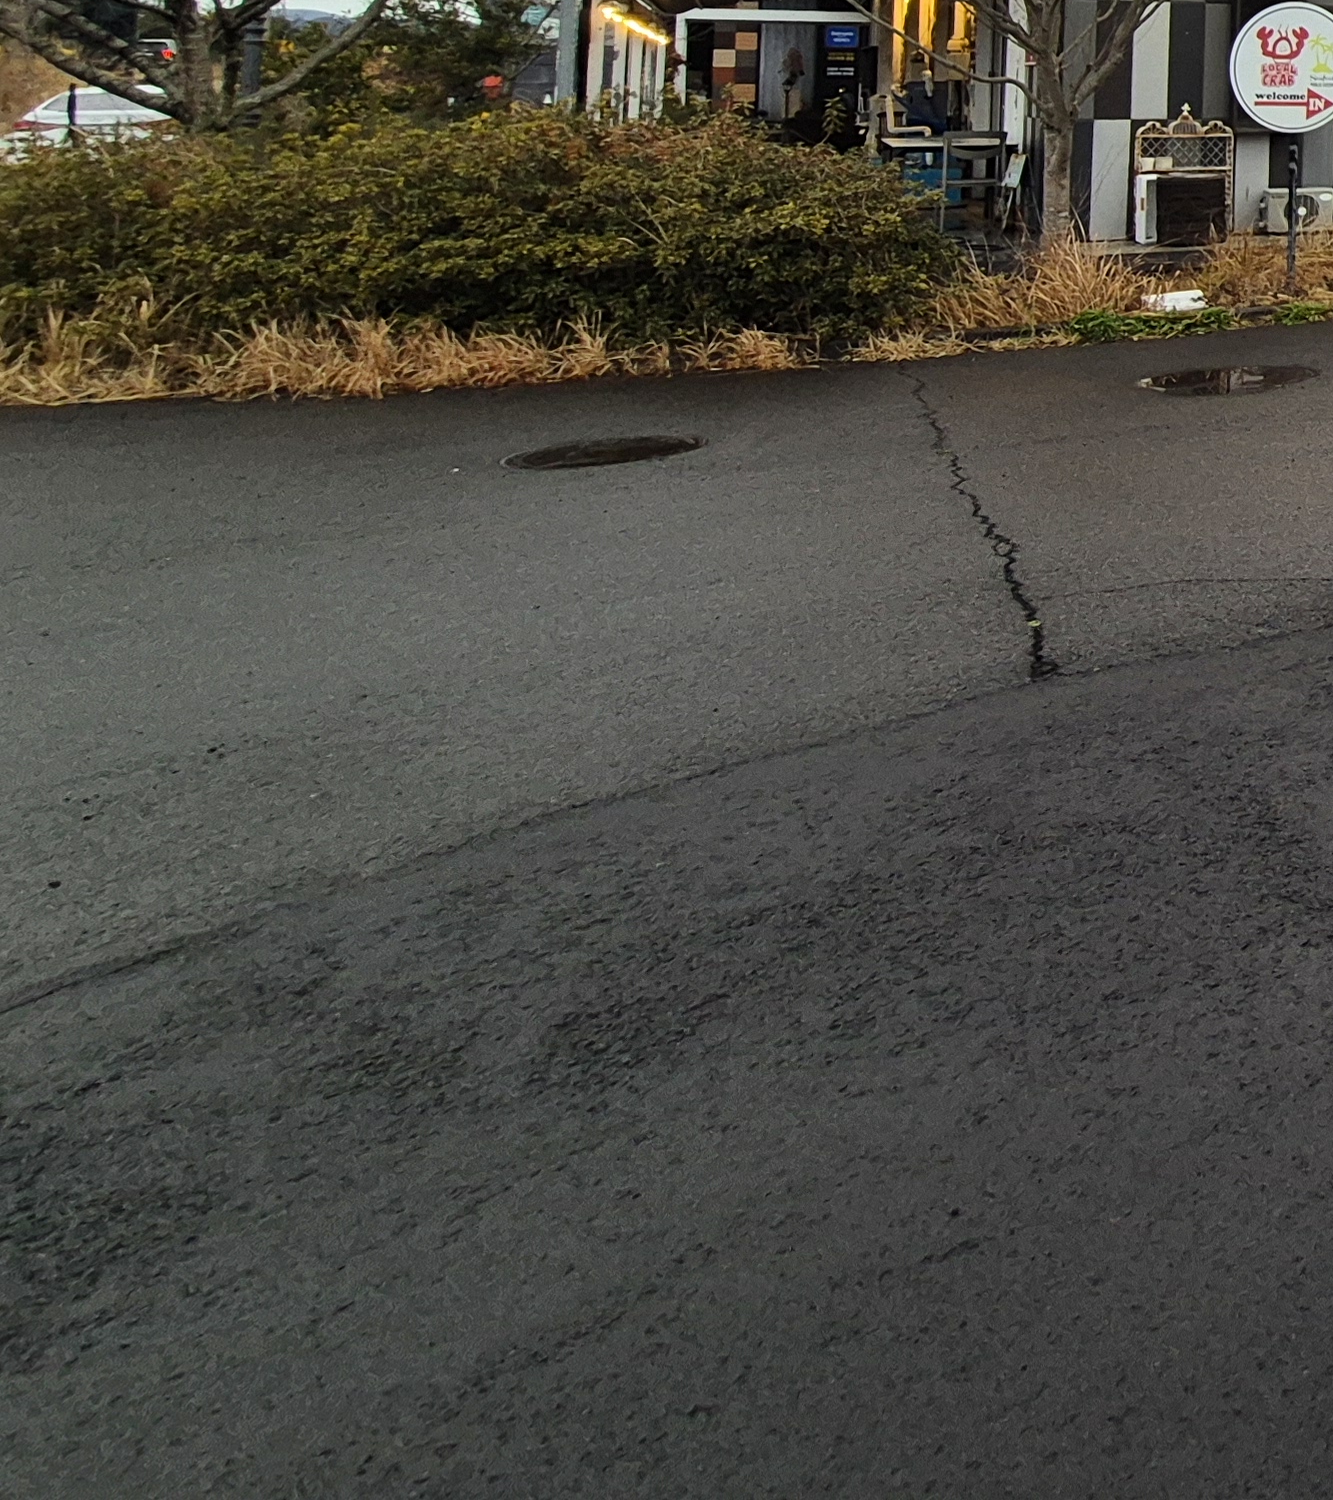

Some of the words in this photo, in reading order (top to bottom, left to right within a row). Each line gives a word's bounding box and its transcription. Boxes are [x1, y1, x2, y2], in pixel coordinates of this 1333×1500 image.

[1261, 63, 1298, 75] LOCAL
[1262, 74, 1296, 87] CRAB
[1255, 92, 1305, 100] welcome
[1309, 98, 1325, 110] IN
